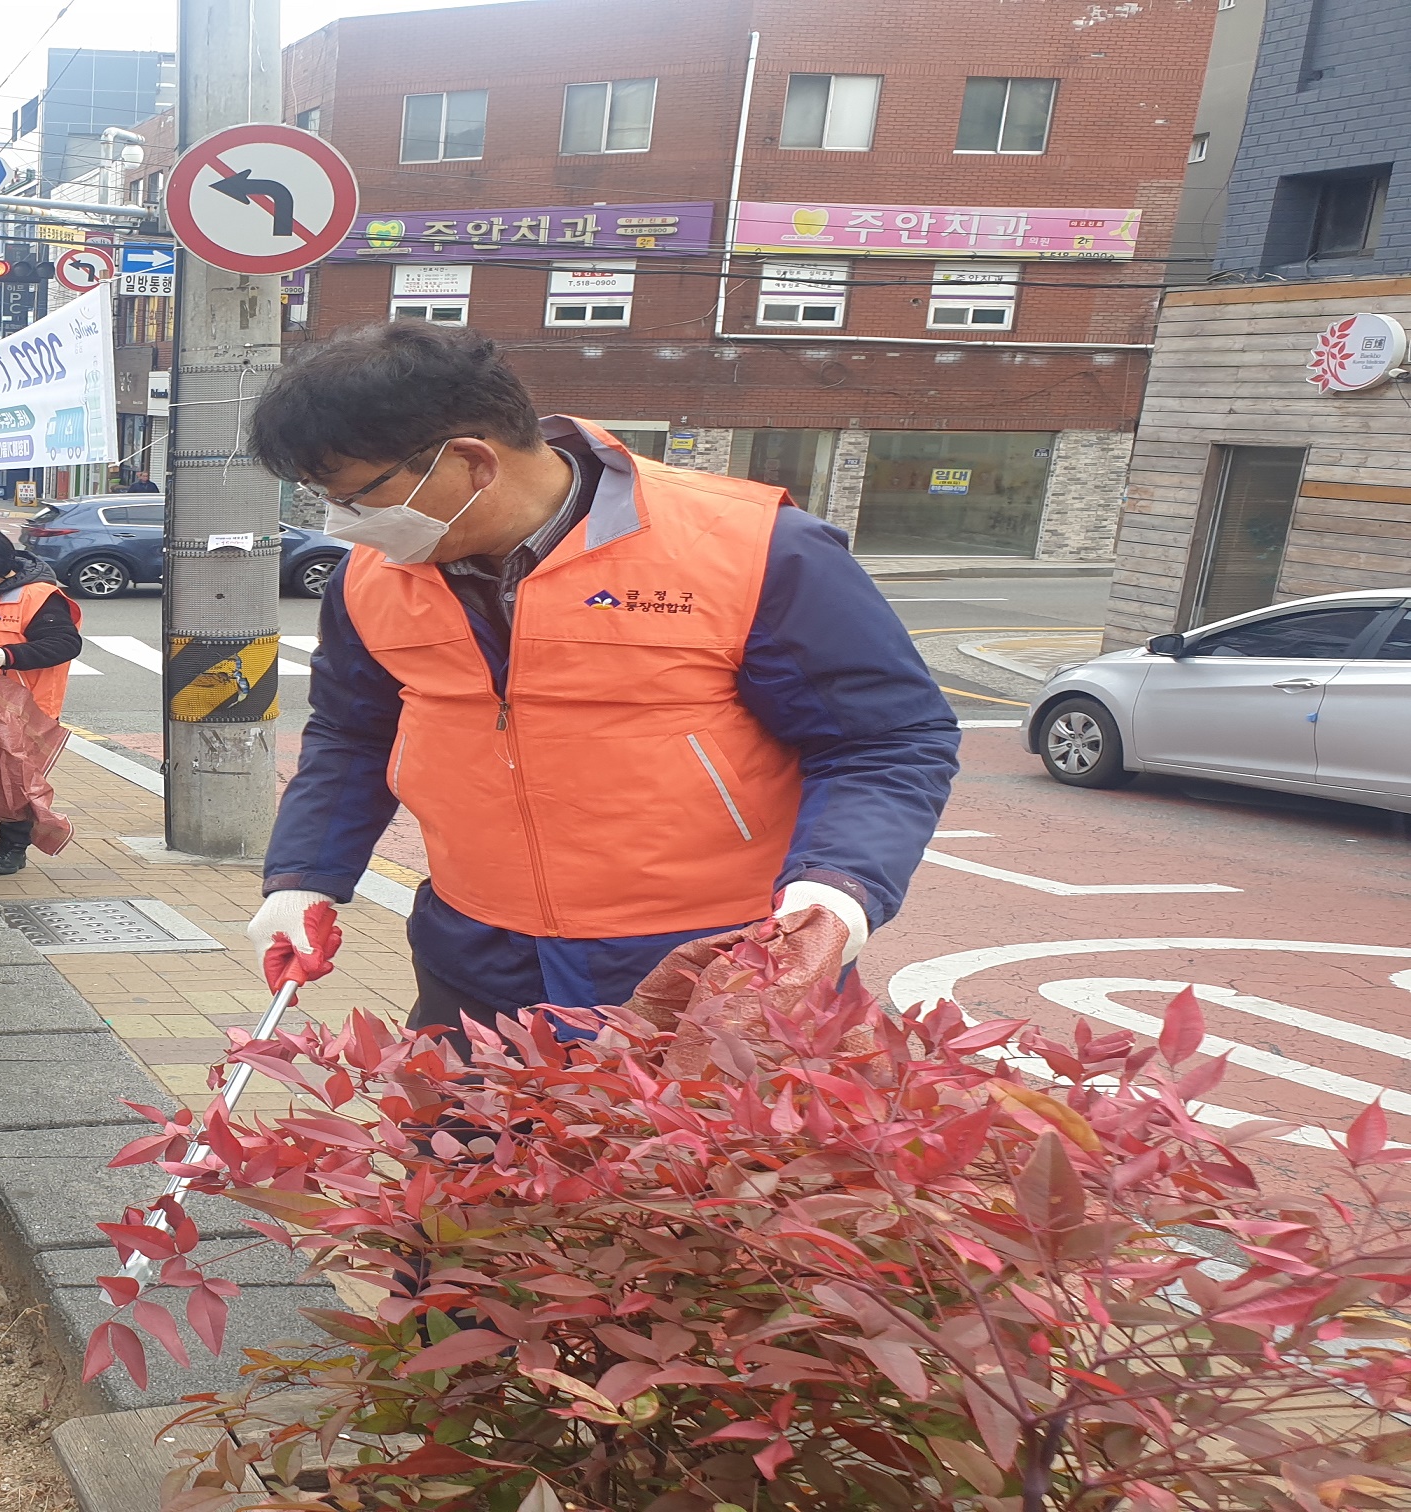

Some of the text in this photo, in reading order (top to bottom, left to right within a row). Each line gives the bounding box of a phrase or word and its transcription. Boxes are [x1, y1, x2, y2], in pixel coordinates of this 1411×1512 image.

[419, 213, 602, 252] 주안치과
[844, 209, 1033, 247] 주안치과
[125, 275, 173, 294] 일방통행
[568, 279, 617, 287] T.518-0900
[935, 470, 968, 481] 임대
[625, 589, 694, 603] 금정구
